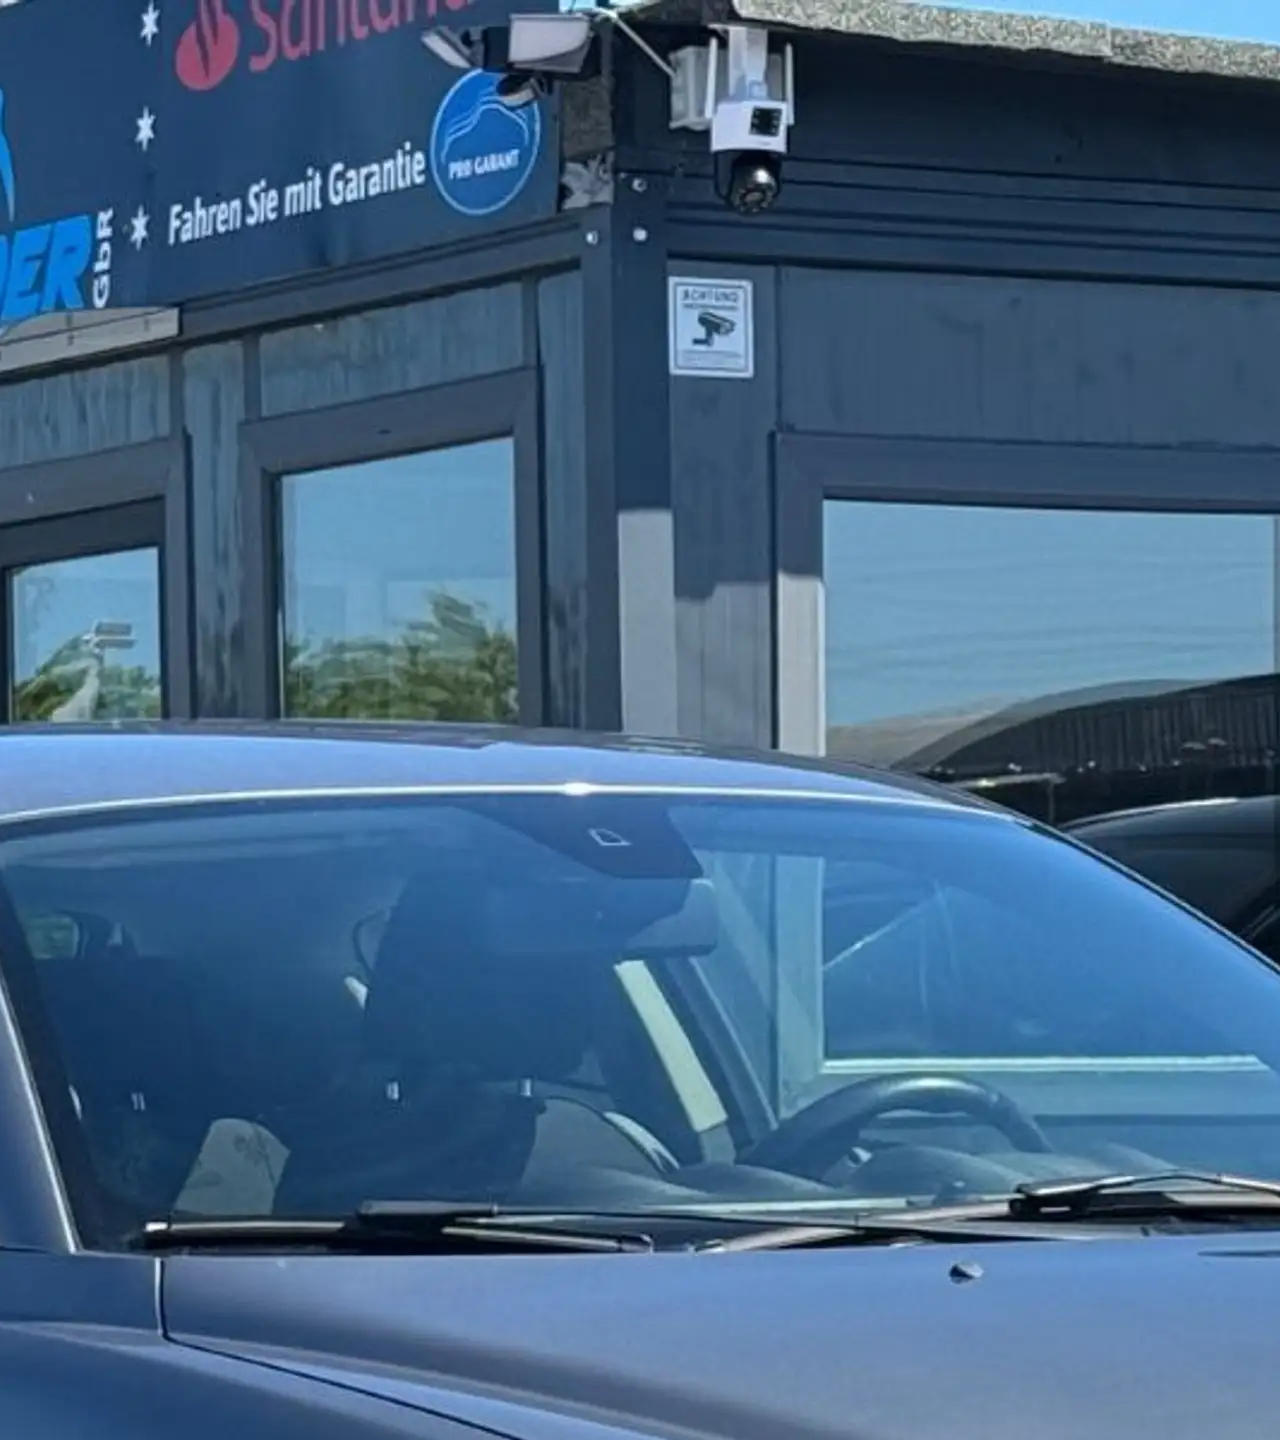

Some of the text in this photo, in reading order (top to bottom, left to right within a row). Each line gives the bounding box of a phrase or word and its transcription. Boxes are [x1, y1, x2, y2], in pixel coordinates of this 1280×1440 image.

[169, 141, 426, 247] Fahren Sie mit Garantie
